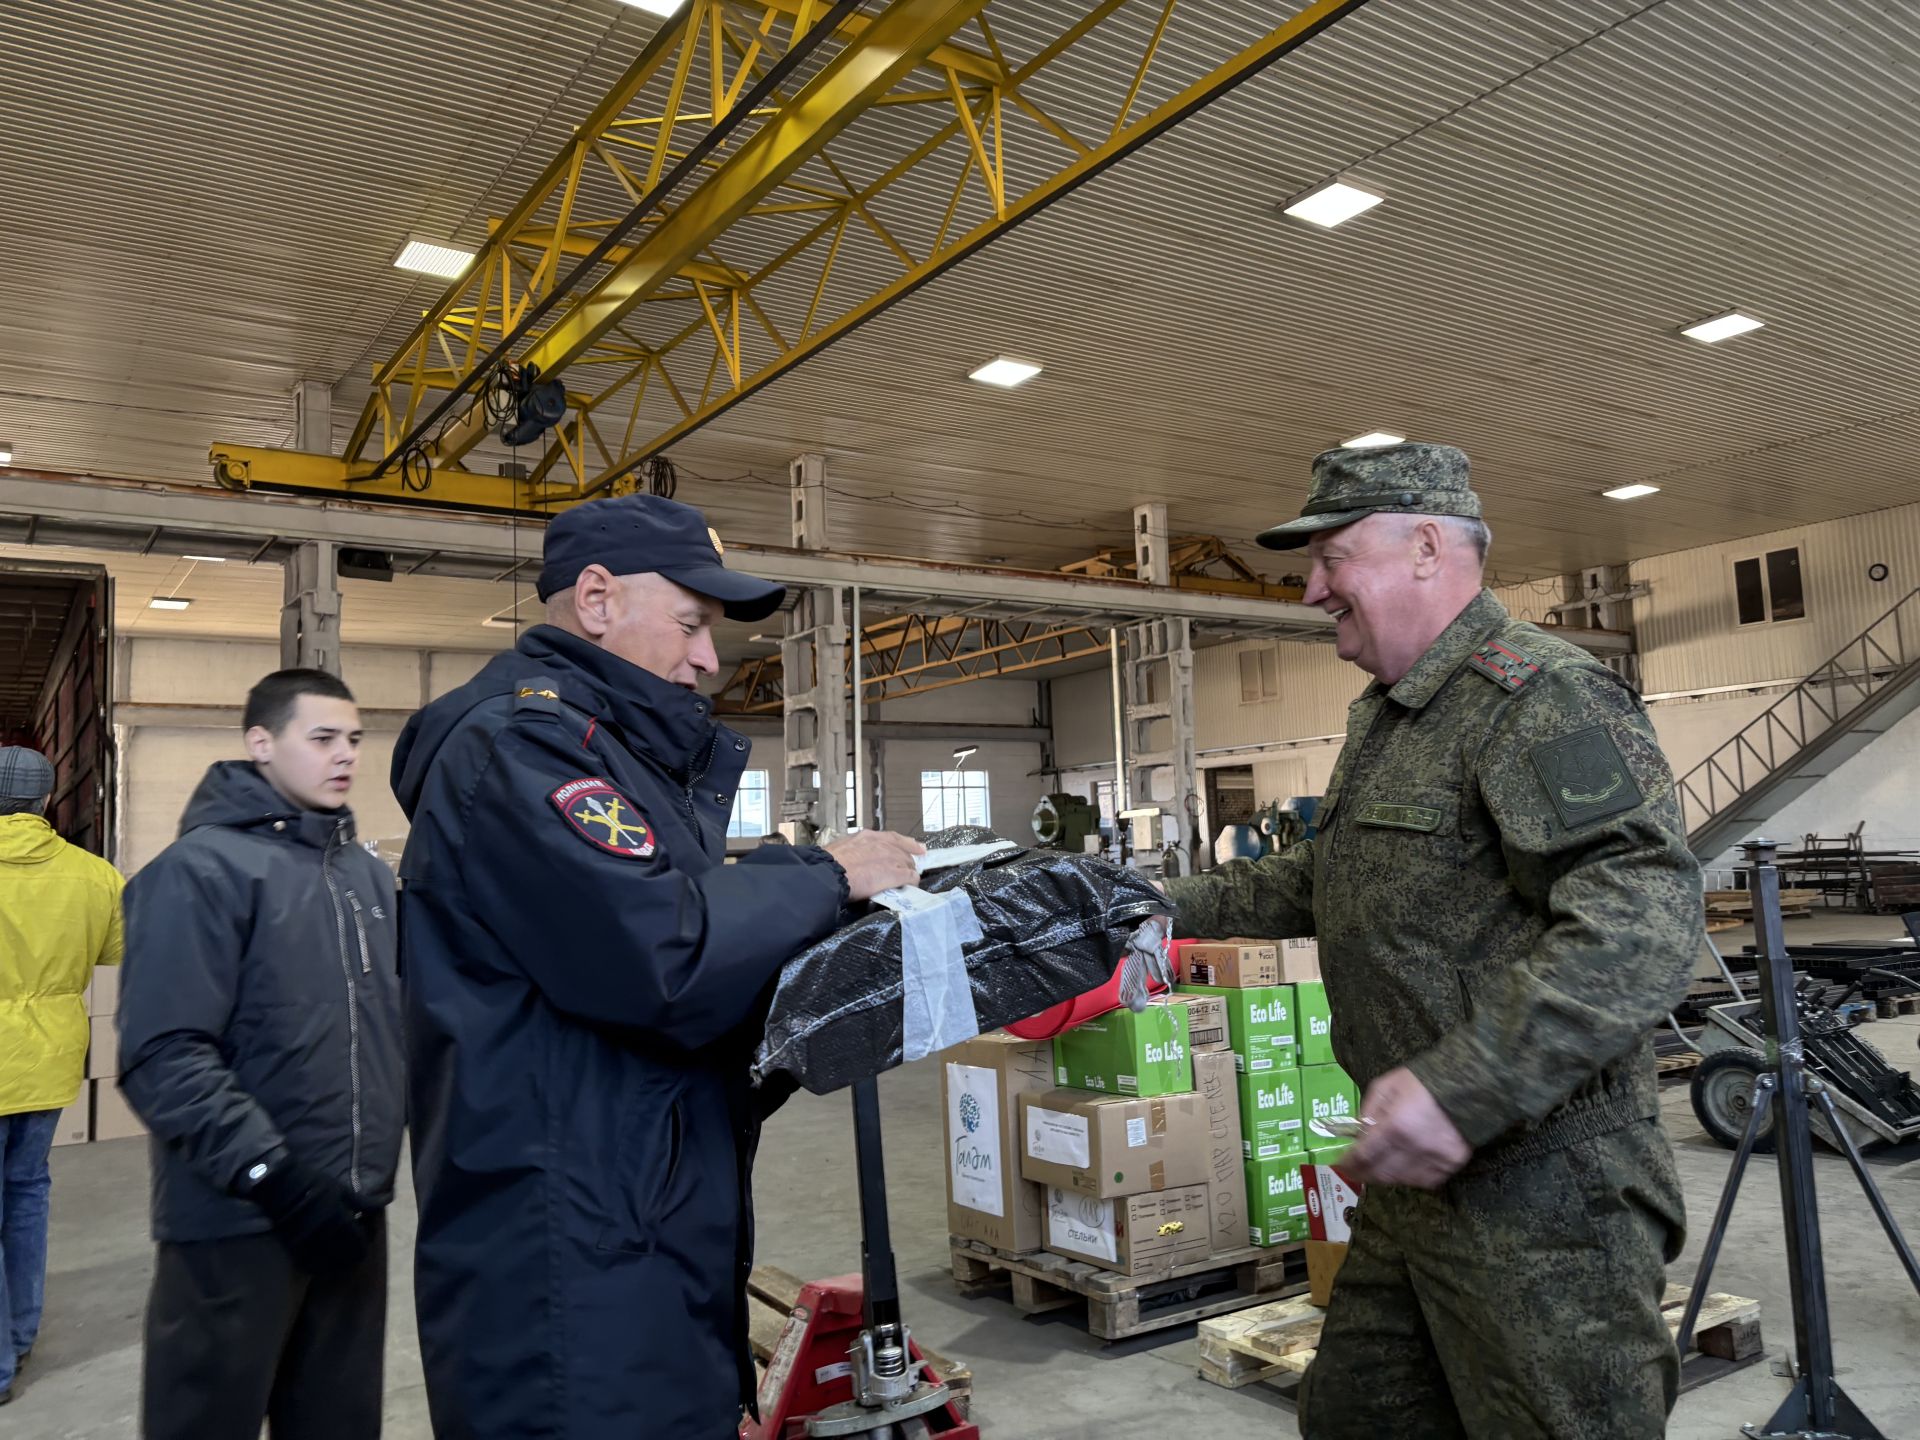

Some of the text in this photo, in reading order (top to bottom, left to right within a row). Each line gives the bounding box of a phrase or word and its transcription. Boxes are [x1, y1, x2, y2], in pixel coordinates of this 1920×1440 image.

[555, 779, 606, 803] ПОЛИЦИЯ
[1250, 998, 1287, 1024] Eco Life
[1309, 1016, 1327, 1036] Eco
[1145, 1043, 1162, 1063] Eco
[1085, 1075, 1095, 1088] Eco
[1094, 1075, 1105, 1089] Life
[1257, 1083, 1295, 1109] Eco Life
[1312, 1093, 1350, 1118] Eco Life
[1268, 1168, 1303, 1196] Eco Life
[1067, 1228, 1098, 1244] СТЕЛЬКИ
